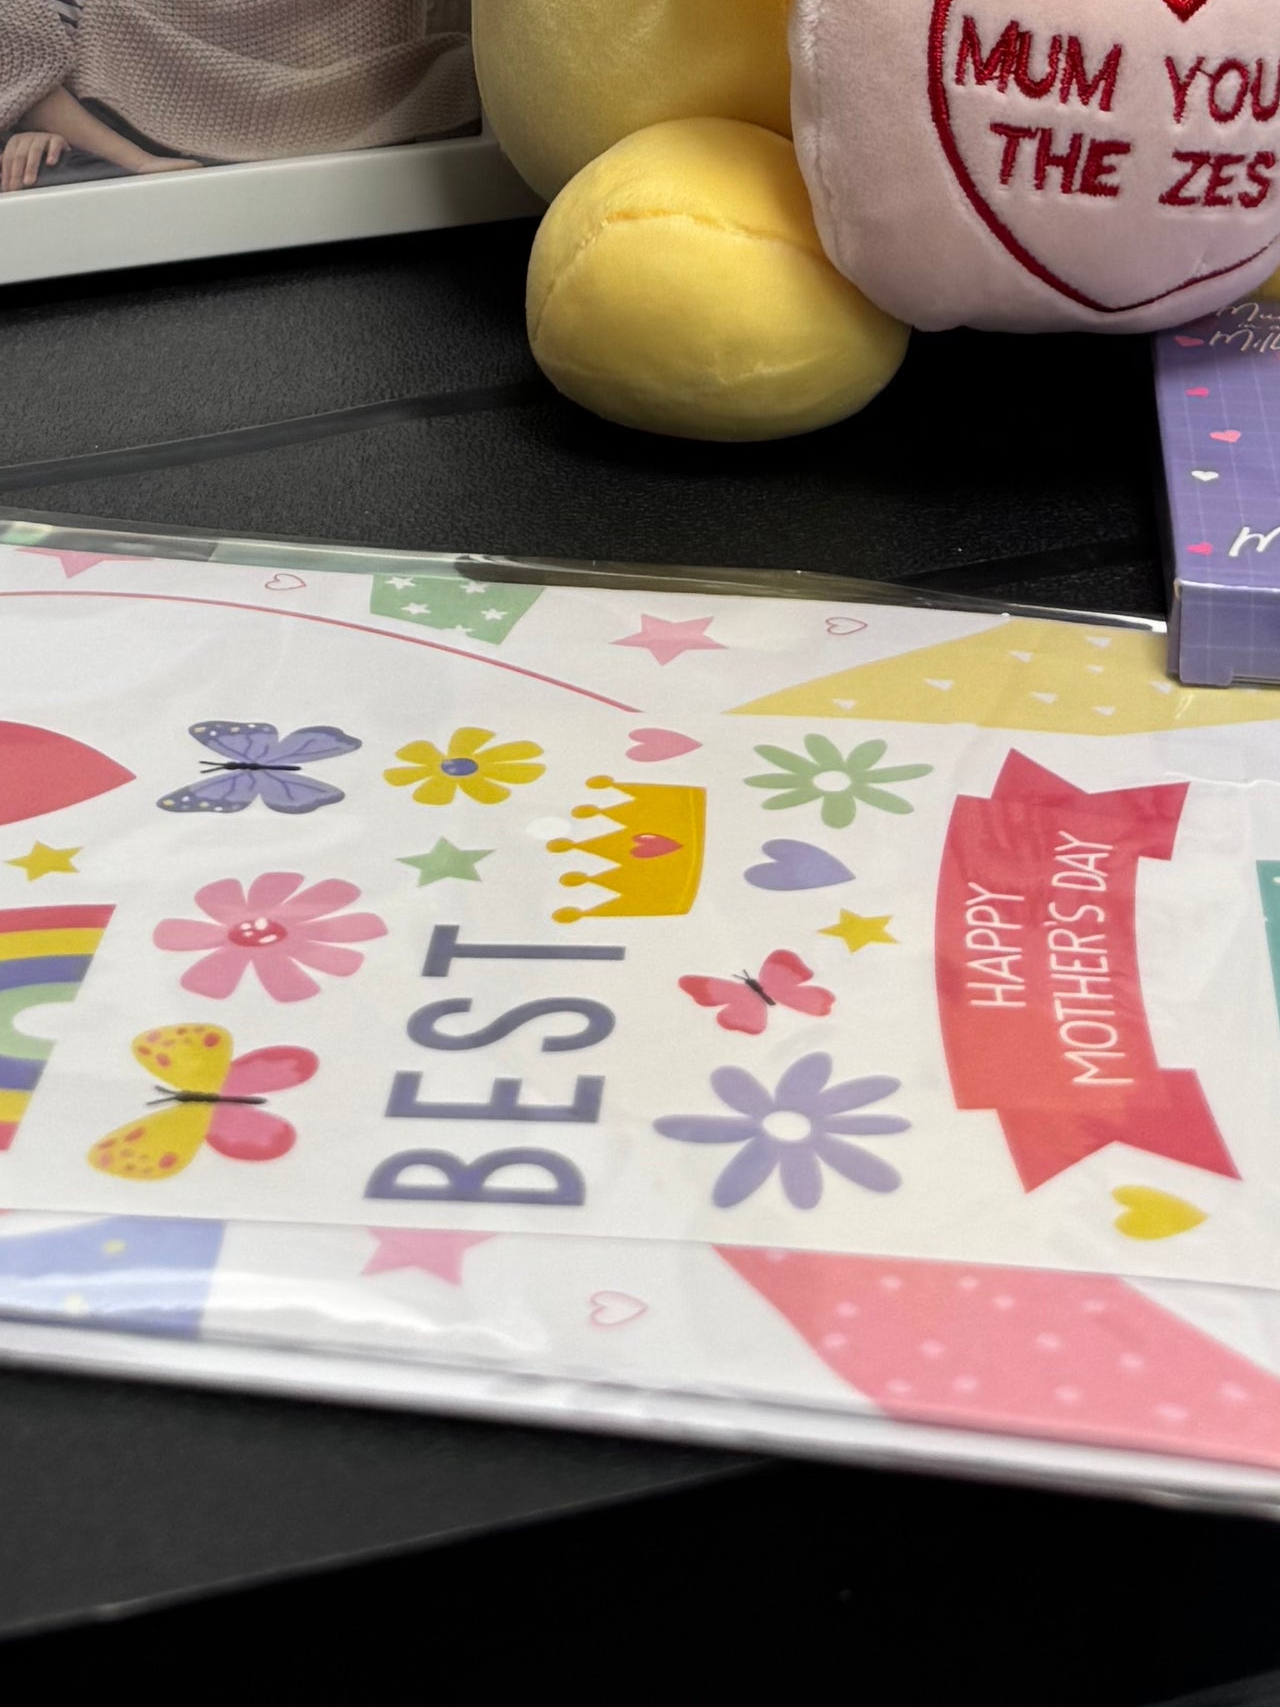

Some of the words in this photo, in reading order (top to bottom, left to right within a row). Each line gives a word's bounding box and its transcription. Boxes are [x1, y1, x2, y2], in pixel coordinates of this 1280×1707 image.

[955, 16, 1122, 112] MUM
[990, 121, 1131, 196] THE
[1051, 830, 1114, 892] DAY
[963, 880, 1027, 1009] HAPPY
[1044, 900, 1134, 1086] MOTHER'S
[363, 924, 626, 1206] BEST
